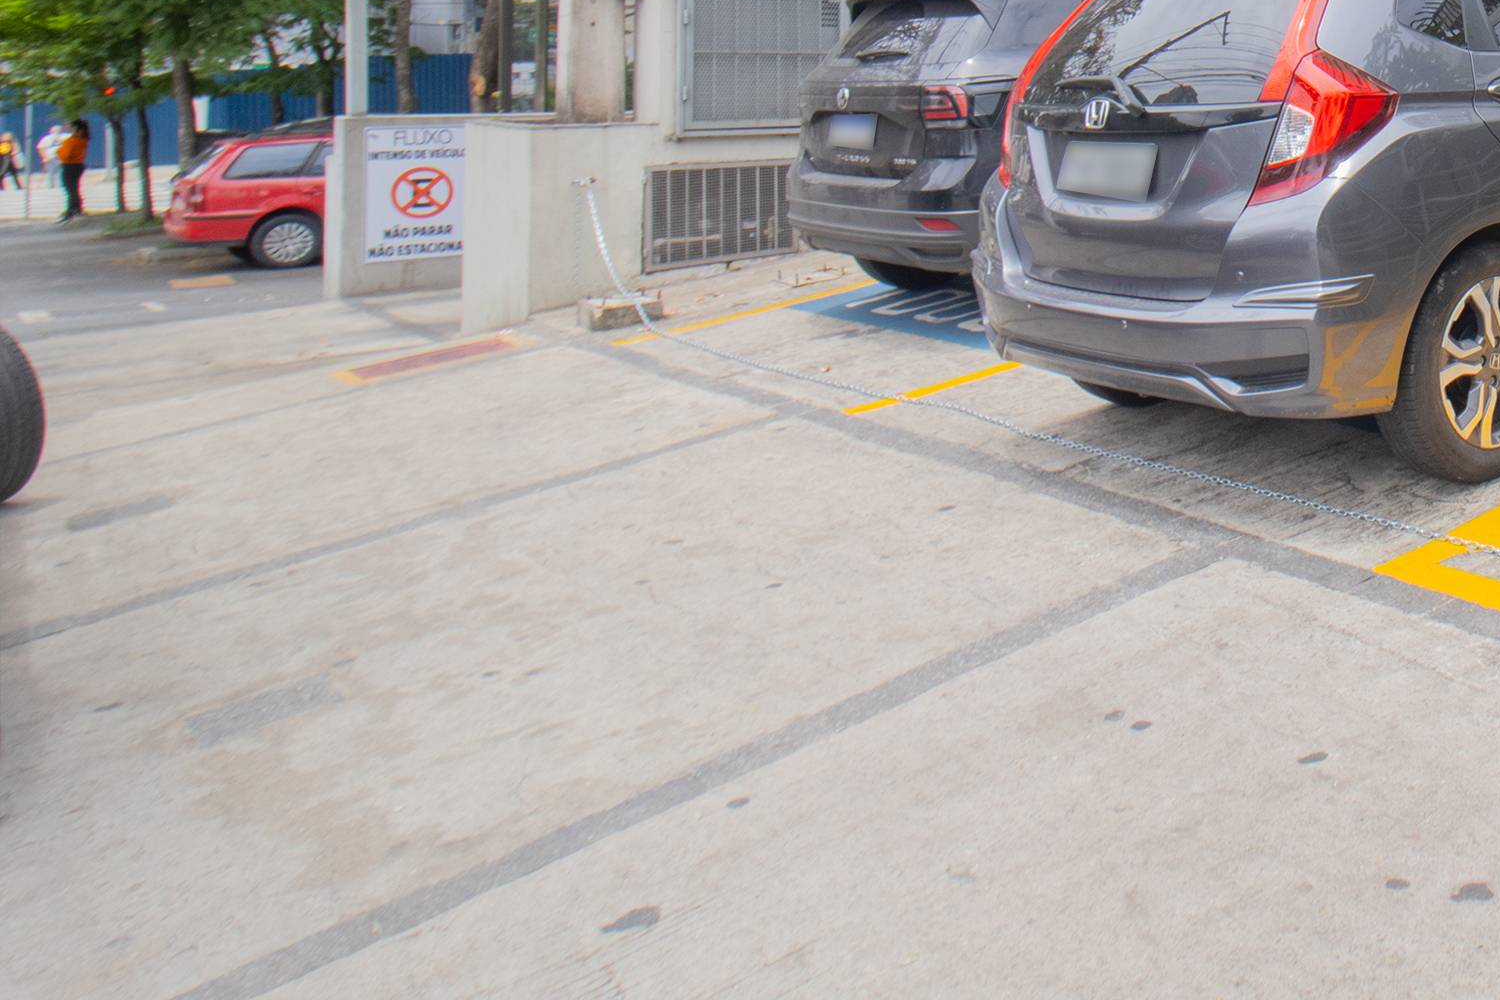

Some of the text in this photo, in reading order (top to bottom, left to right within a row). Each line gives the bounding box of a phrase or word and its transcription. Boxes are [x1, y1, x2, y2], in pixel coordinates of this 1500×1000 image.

[394, 129, 453, 146] FLUXO
[368, 147, 465, 161] INTENSO DE VEÍCUL
[383, 224, 453, 239] NÃO PARAR
[368, 240, 464, 258] NÃO ESTACIONA
